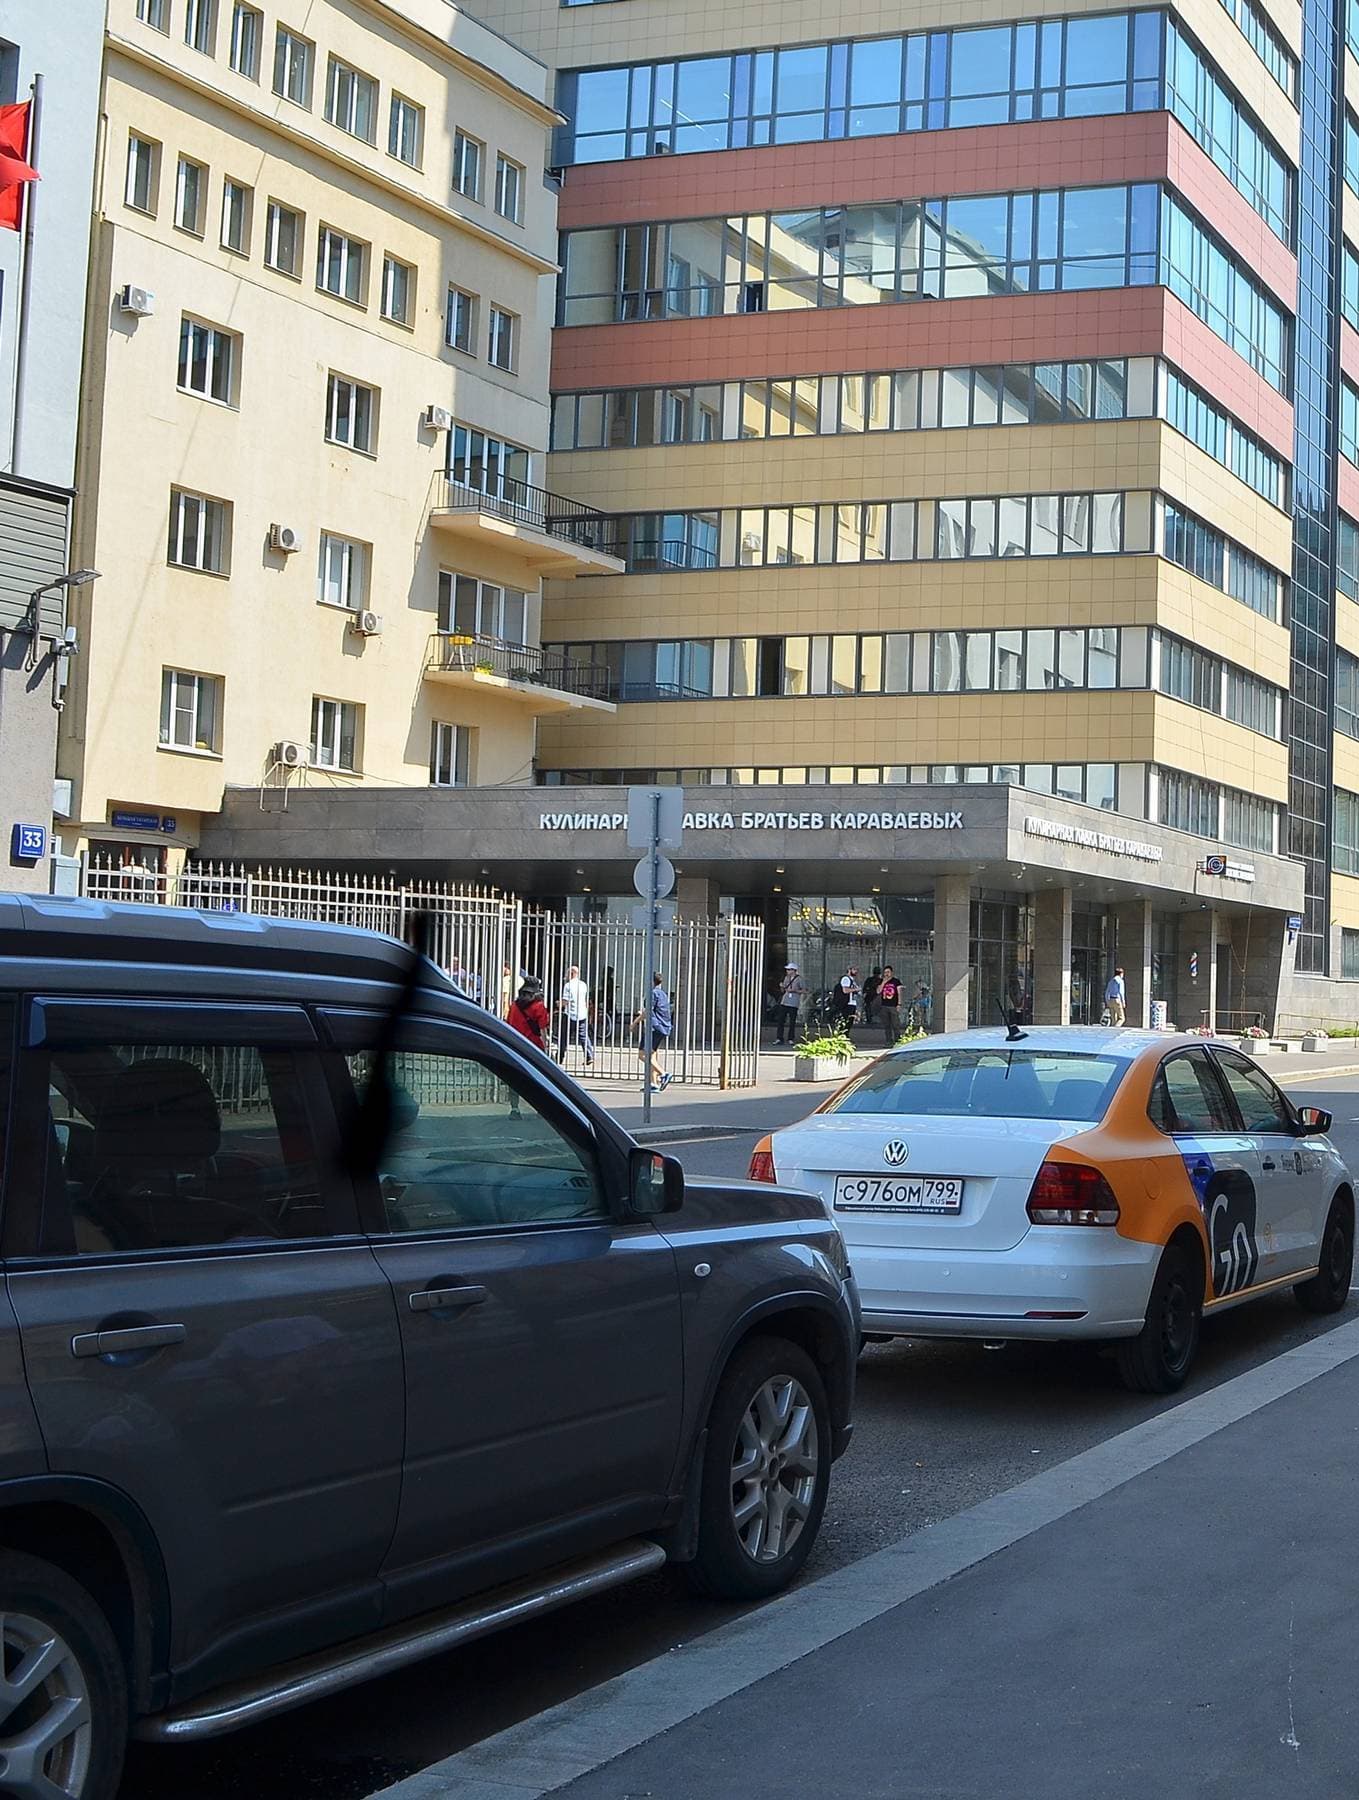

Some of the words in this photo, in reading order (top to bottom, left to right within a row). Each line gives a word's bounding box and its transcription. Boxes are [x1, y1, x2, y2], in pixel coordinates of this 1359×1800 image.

[539, 813, 629, 830] КУЛИНАР
[682, 812, 735, 830] АВКА
[741, 812, 824, 830] БРАТЬЕВ
[830, 812, 964, 830] КАРАВАЕВЫХ
[23, 830, 42, 849] 33
[926, 1181, 955, 1198] 799
